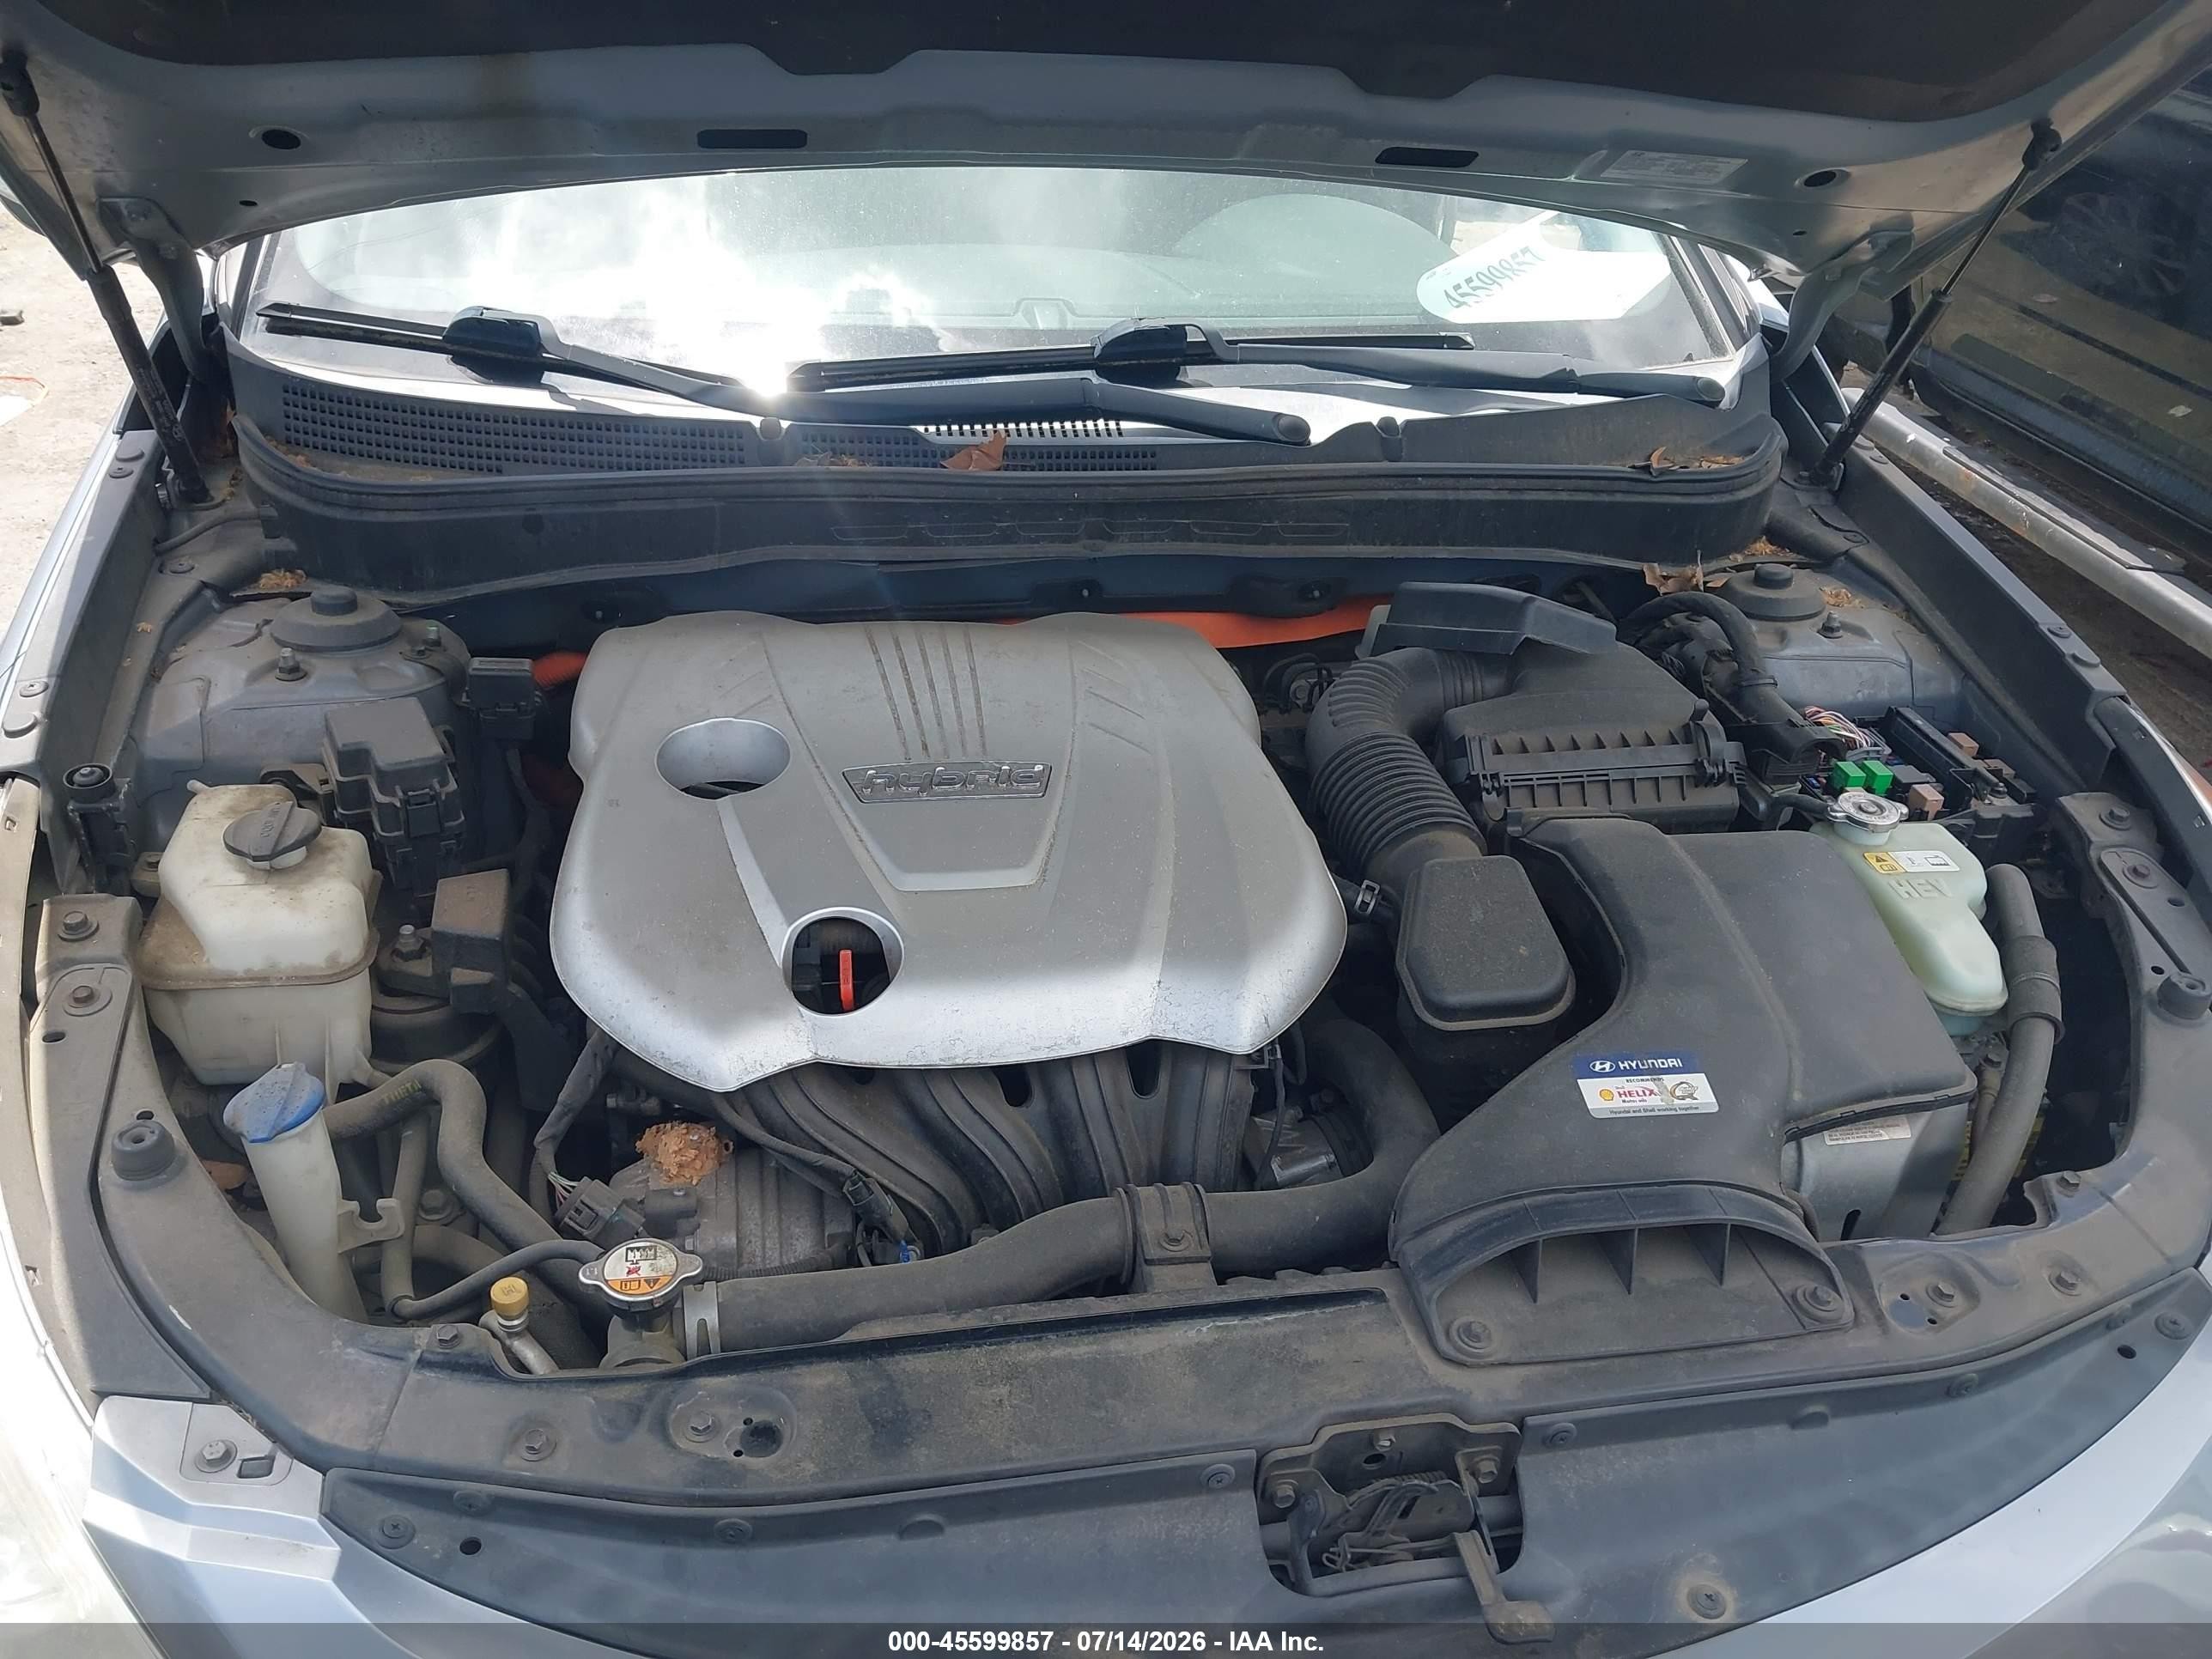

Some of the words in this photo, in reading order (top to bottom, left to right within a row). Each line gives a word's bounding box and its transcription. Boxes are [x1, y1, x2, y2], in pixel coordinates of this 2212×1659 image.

[861, 764, 1045, 797] hybrid
[1887, 878, 1954, 899] HEV
[1618, 1058, 1683, 1071] HYUNDAI
[1617, 1088, 1657, 1099] HELIX
